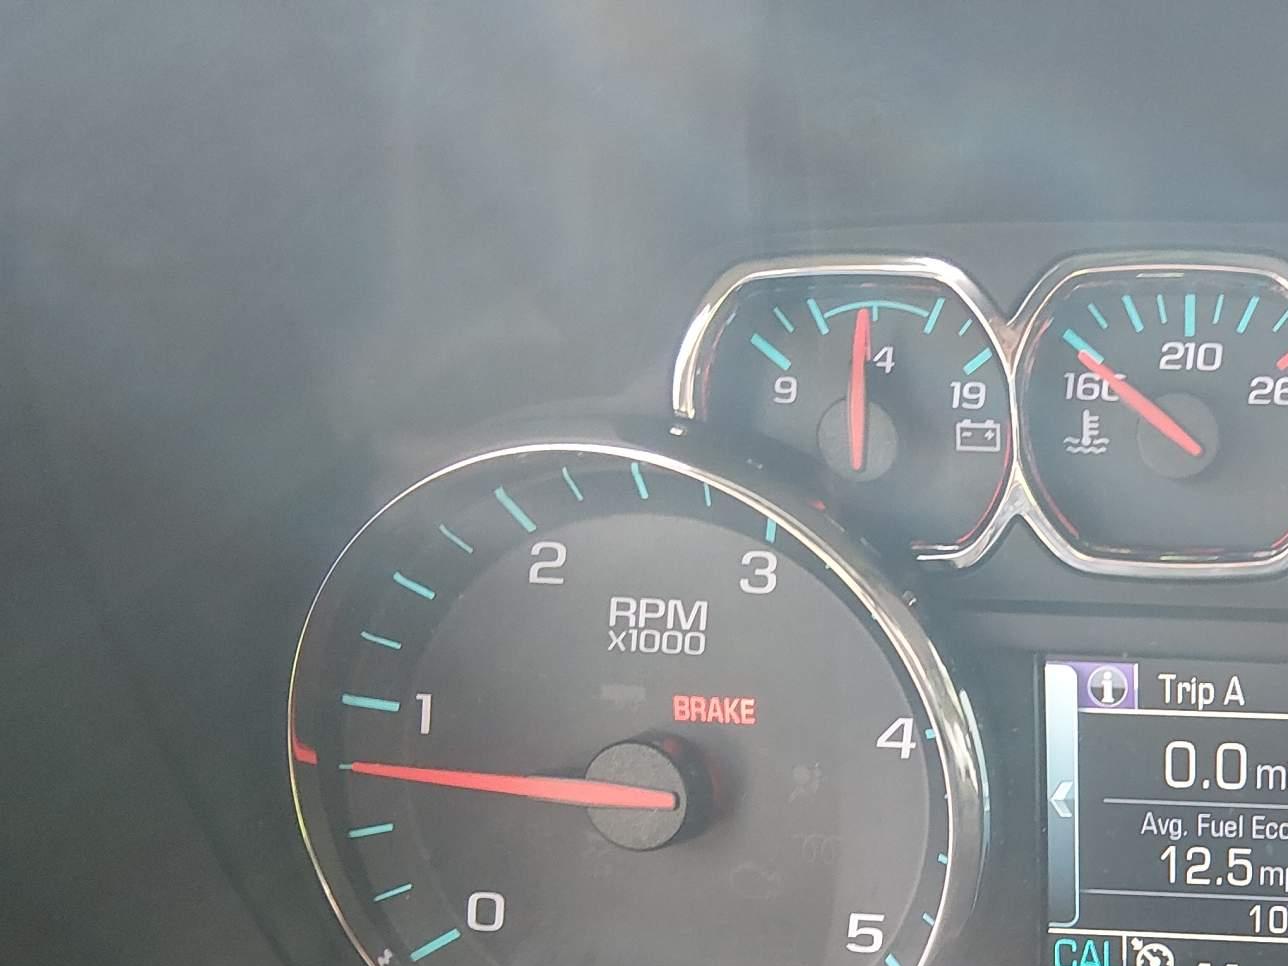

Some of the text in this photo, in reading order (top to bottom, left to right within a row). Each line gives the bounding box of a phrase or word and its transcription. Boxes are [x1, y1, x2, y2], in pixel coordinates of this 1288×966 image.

[1159, 341, 1223, 371] 210
[774, 376, 797, 404] 9
[950, 381, 986, 409] 19
[529, 541, 567, 584] 2
[739, 550, 778, 594] 3
[608, 597, 708, 632] RPM
[673, 695, 755, 724] BRAKE
[1157, 674, 1245, 709] Trip A
[415, 693, 432, 734] 1
[876, 717, 917, 759] 4
[1165, 740, 1247, 790] 0.0
[1140, 811, 1188, 841] Avg.
[1197, 813, 1244, 838] Fuel
[1160, 845, 1253, 887] 12.5
[467, 892, 505, 932] 0
[846, 913, 886, 954] 5
